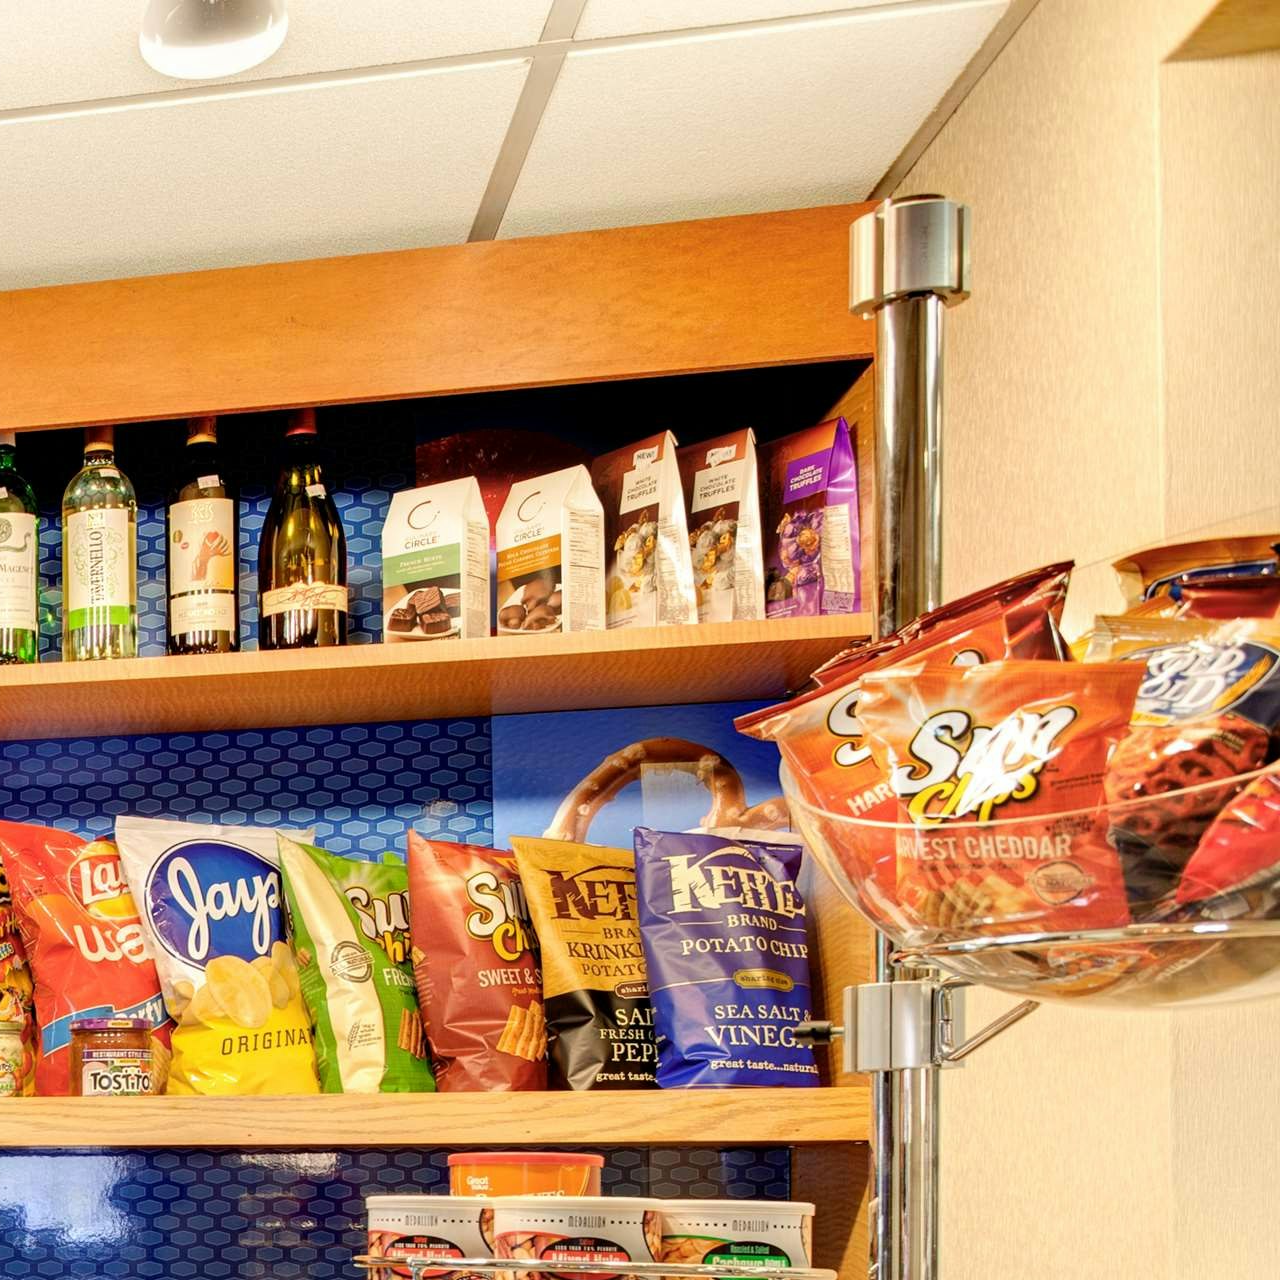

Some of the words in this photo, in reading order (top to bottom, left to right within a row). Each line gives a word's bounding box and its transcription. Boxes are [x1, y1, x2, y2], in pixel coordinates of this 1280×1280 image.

[636, 450, 655, 460] NEW!
[790, 467, 823, 483] CHOCOLATE
[800, 465, 815, 475] DARK
[627, 480, 657, 495] CHOCOLATE
[699, 478, 735, 492] CHOCOLATE
[790, 475, 822, 491] TRUFFLES
[627, 486, 657, 501] TRUFFLES
[699, 485, 735, 500] TRUFFLES
[404, 536, 438, 550] CIRCLE
[514, 528, 543, 543] CIRCLE
[963, 833, 1073, 860] CHEDDAR
[662, 847, 806, 919] KETTLE
[167, 856, 280, 961] Jays
[727, 914, 778, 931] BRAND
[681, 935, 768, 957] POTATO
[770, 940, 809, 960] CHIP
[478, 969, 522, 988] SWEET
[524, 969, 535, 985] &
[714, 1004, 755, 1020] SEA
[757, 1003, 802, 1022] SALT
[600, 1029, 645, 1041] FRESH
[704, 1025, 814, 1050] VINEG
[221, 1029, 315, 1057] ORIGINA
[92, 1051, 127, 1059] RESTAURANT
[710, 1060, 746, 1071] great
[596, 1071, 626, 1083] great
[467, 1176, 490, 1187] Great
[404, 1214, 439, 1227] MEDALLION
[568, 1215, 607, 1228] MEDALLION
[731, 1219, 770, 1232] MEDALLION
